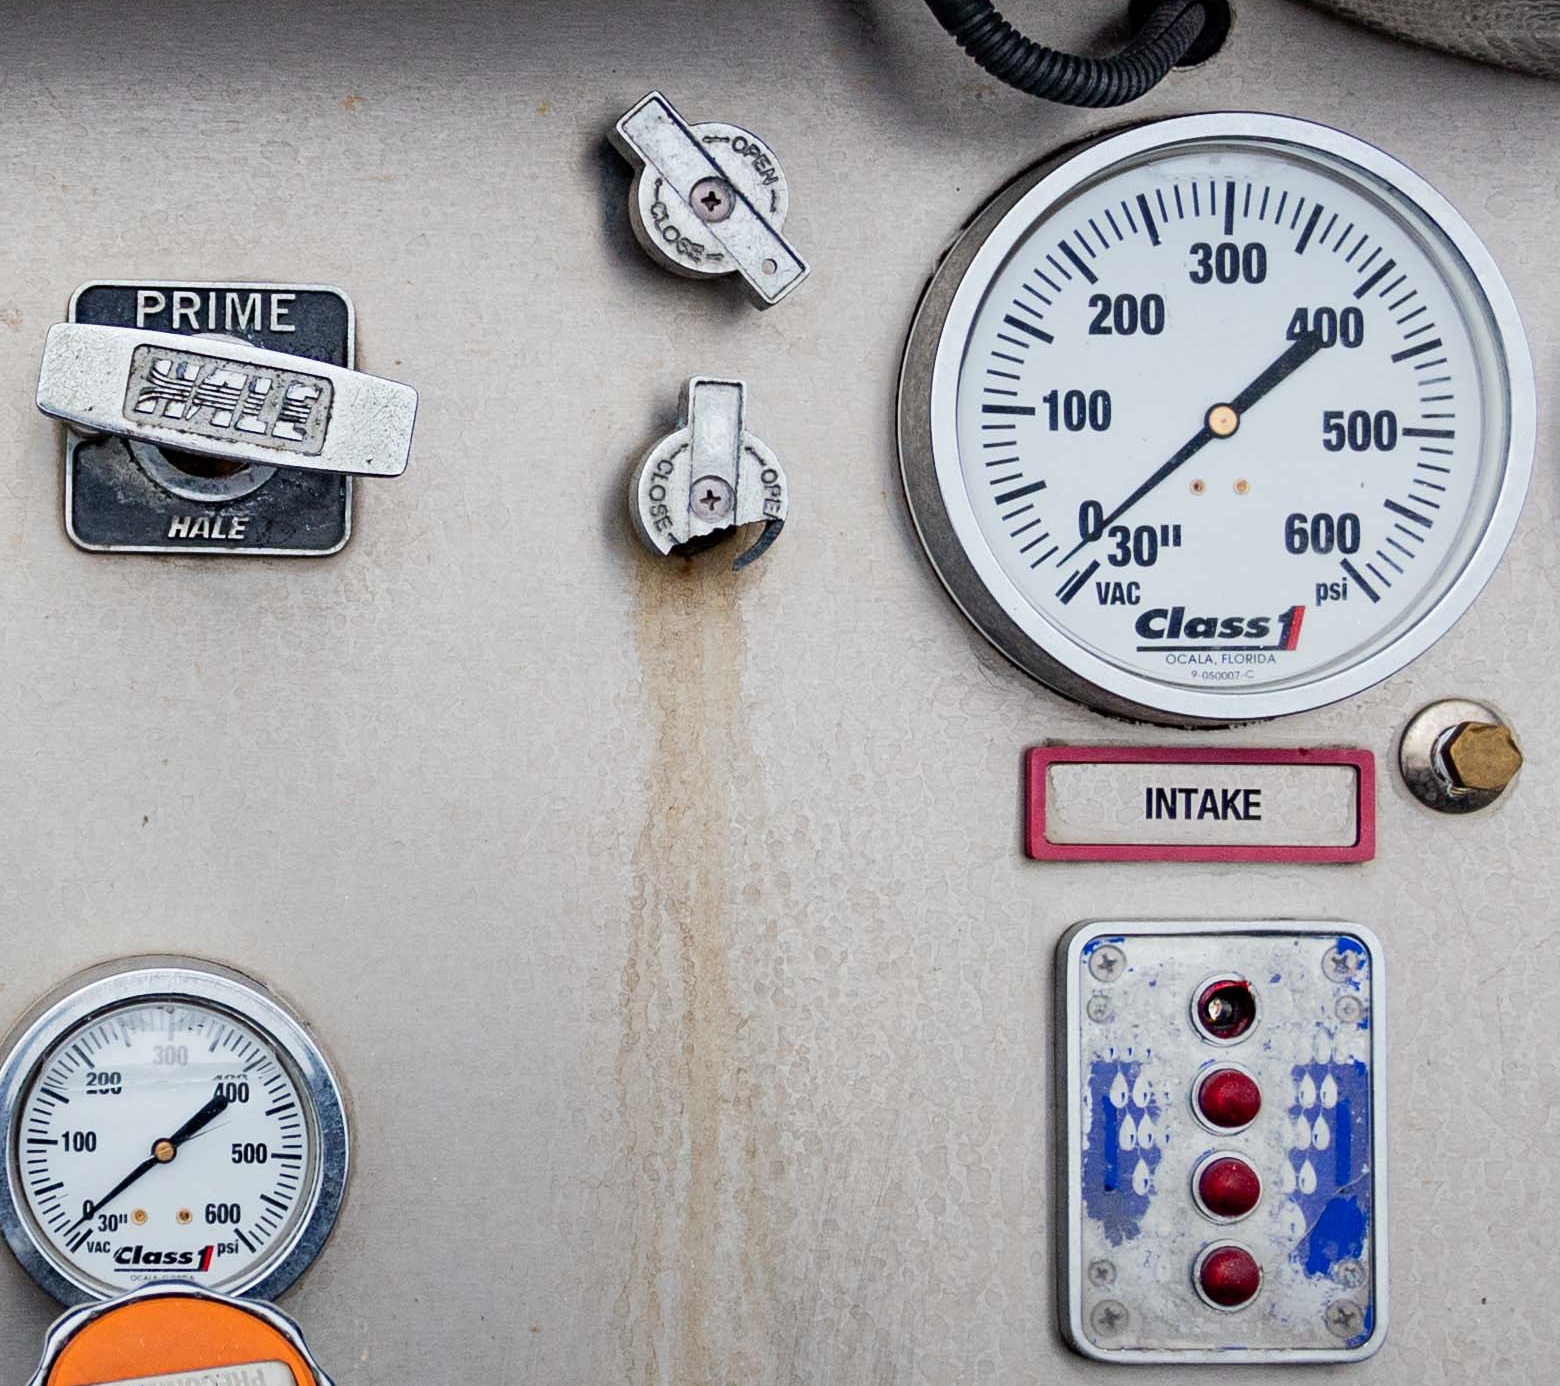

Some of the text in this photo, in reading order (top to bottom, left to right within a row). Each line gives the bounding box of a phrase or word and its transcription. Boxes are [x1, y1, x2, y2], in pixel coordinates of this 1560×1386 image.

[731, 134, 780, 186] OPEN
[649, 200, 706, 263] CLOSE
[1189, 243, 1268, 285] 300
[135, 289, 297, 333] PRIME
[1088, 294, 1166, 336] 200
[1286, 307, 1365, 349] 400
[1042, 390, 1112, 433] 100
[1322, 411, 1398, 453] 500
[647, 458, 674, 533] CLOSE
[167, 515, 251, 541] HALE
[1078, 500, 1103, 543] 0
[1285, 513, 1361, 555] 600
[1096, 581, 1141, 606] VAC
[1315, 577, 1348, 607] psi
[1165, 653, 1276, 666] OCALA, FLORIDA
[1145, 787, 1262, 821] INTAKE
[152, 1044, 189, 1066] 300
[61, 1130, 97, 1152] 100
[231, 1142, 268, 1164] 500
[204, 1203, 242, 1225] 600
[86, 1240, 111, 1254] VAC
[216, 1241, 240, 1258] psi
